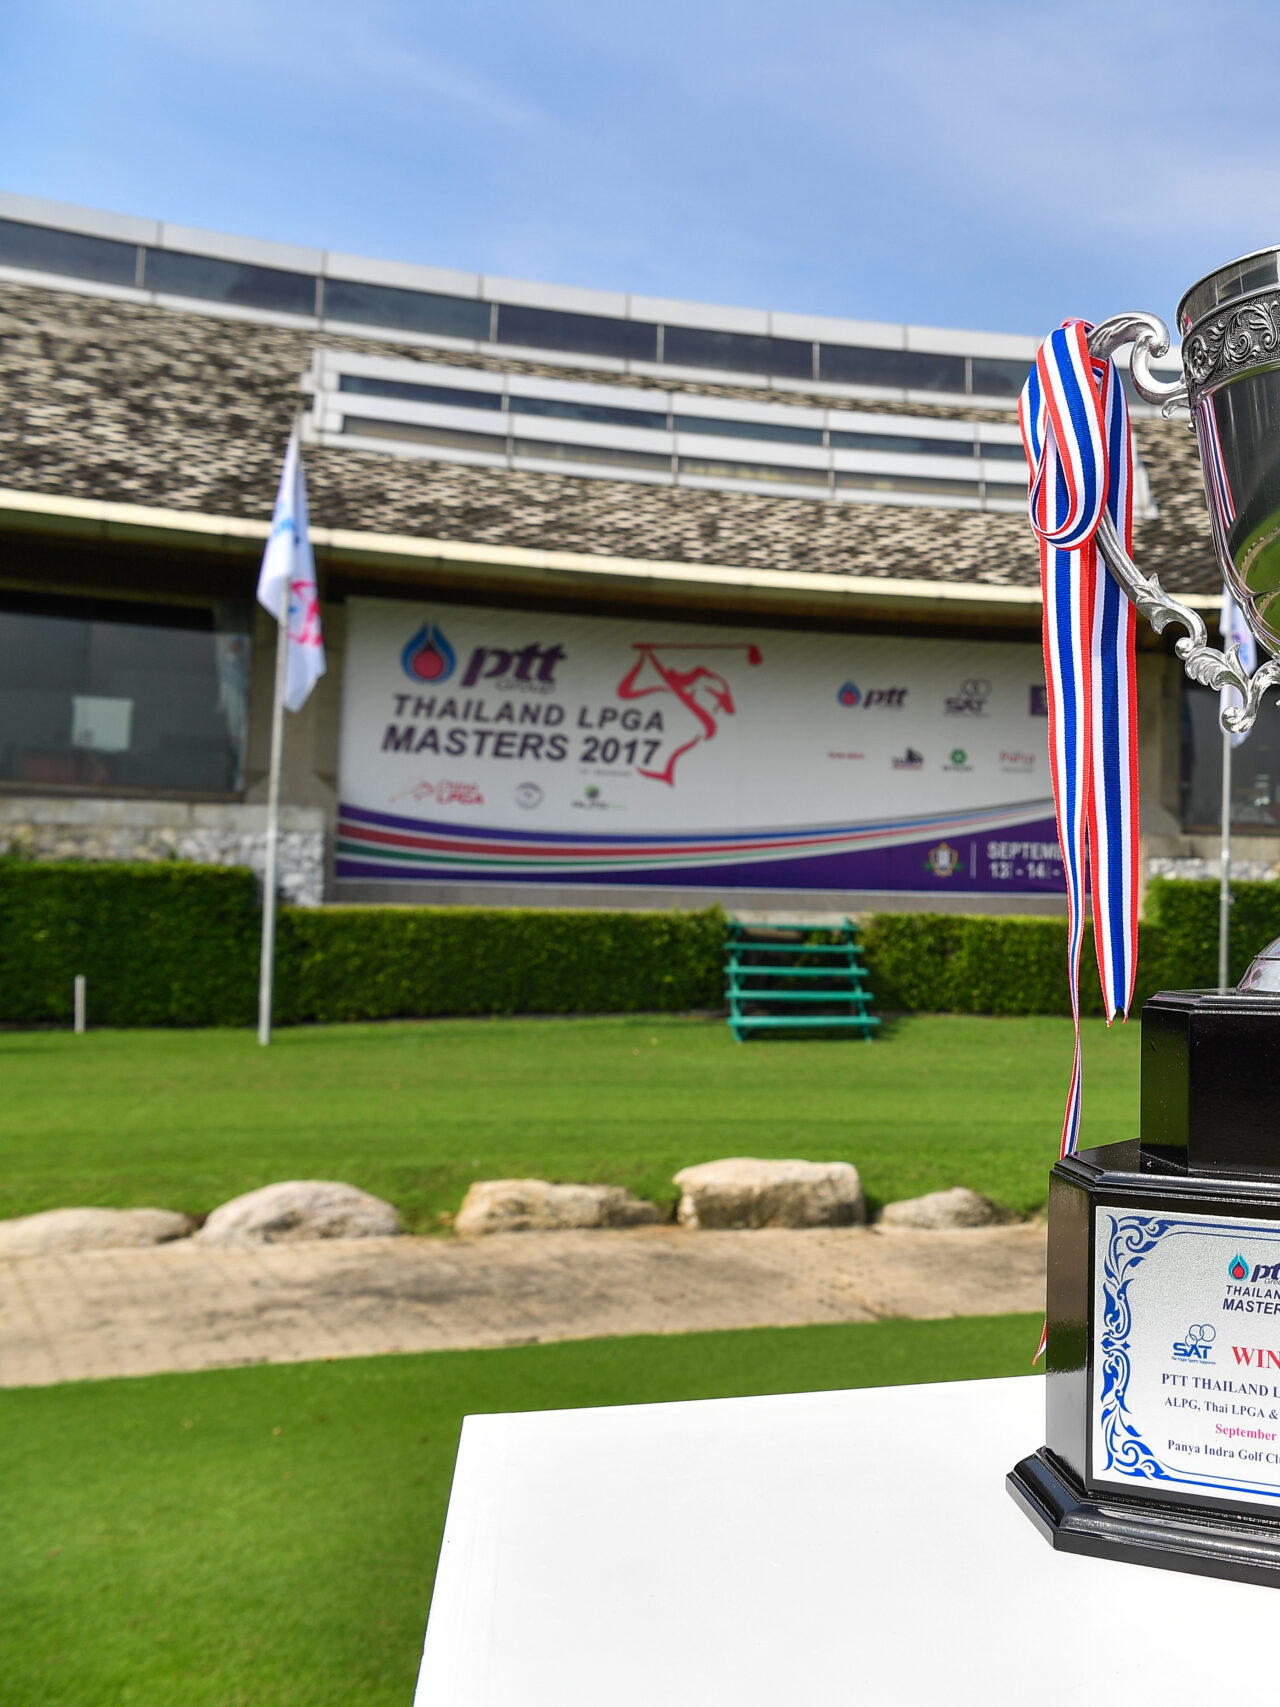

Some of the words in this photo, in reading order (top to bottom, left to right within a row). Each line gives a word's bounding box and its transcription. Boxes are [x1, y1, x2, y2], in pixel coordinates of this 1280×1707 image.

[461, 642, 566, 688] ptt
[863, 686, 908, 709] ptt
[394, 694, 565, 727] THAILAND
[578, 705, 665, 733] LPGA
[381, 723, 569, 761] MASTERS
[580, 735, 661, 766] 2017
[1173, 1342, 1212, 1359] SAT
[1162, 1373, 1188, 1386] PTT
[1192, 1377, 1268, 1396] THAILAND
[1165, 1396, 1200, 1411] ALPG,
[1204, 1401, 1228, 1413] Thai
[1232, 1404, 1265, 1418] LPGA
[1268, 1409, 1278, 1419] &
[1215, 1423, 1277, 1441] September
[1168, 1439, 1200, 1455] Panya
[1205, 1445, 1234, 1458] Indra
[1238, 1449, 1263, 1462] Golf
